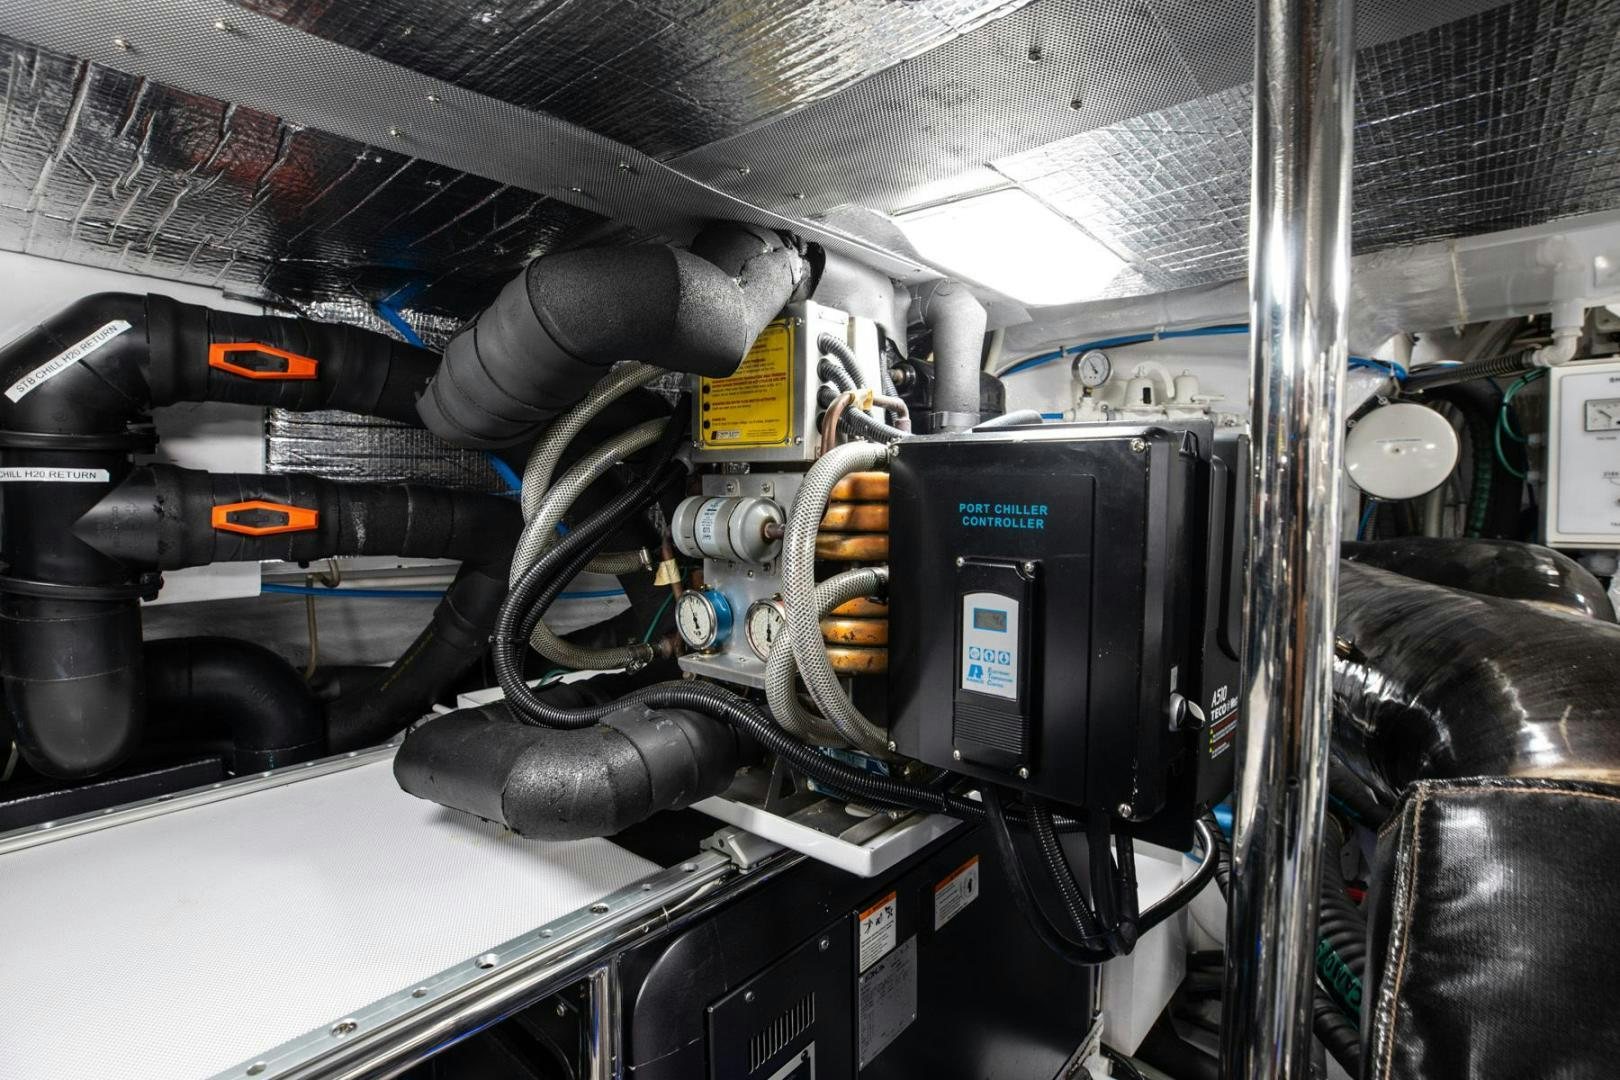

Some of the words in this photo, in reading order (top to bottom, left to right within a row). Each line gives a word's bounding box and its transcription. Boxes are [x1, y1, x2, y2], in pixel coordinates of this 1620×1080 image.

[16, 375, 36, 393] STB
[36, 361, 63, 379] CHILL
[81, 324, 119, 351] RETURN
[48, 470, 97, 479] RETURN
[959, 503, 991, 514] PORT
[994, 503, 1049, 516] CHILLER
[962, 516, 1044, 529] CONTROLLER
[1211, 704, 1227, 721] TECO
